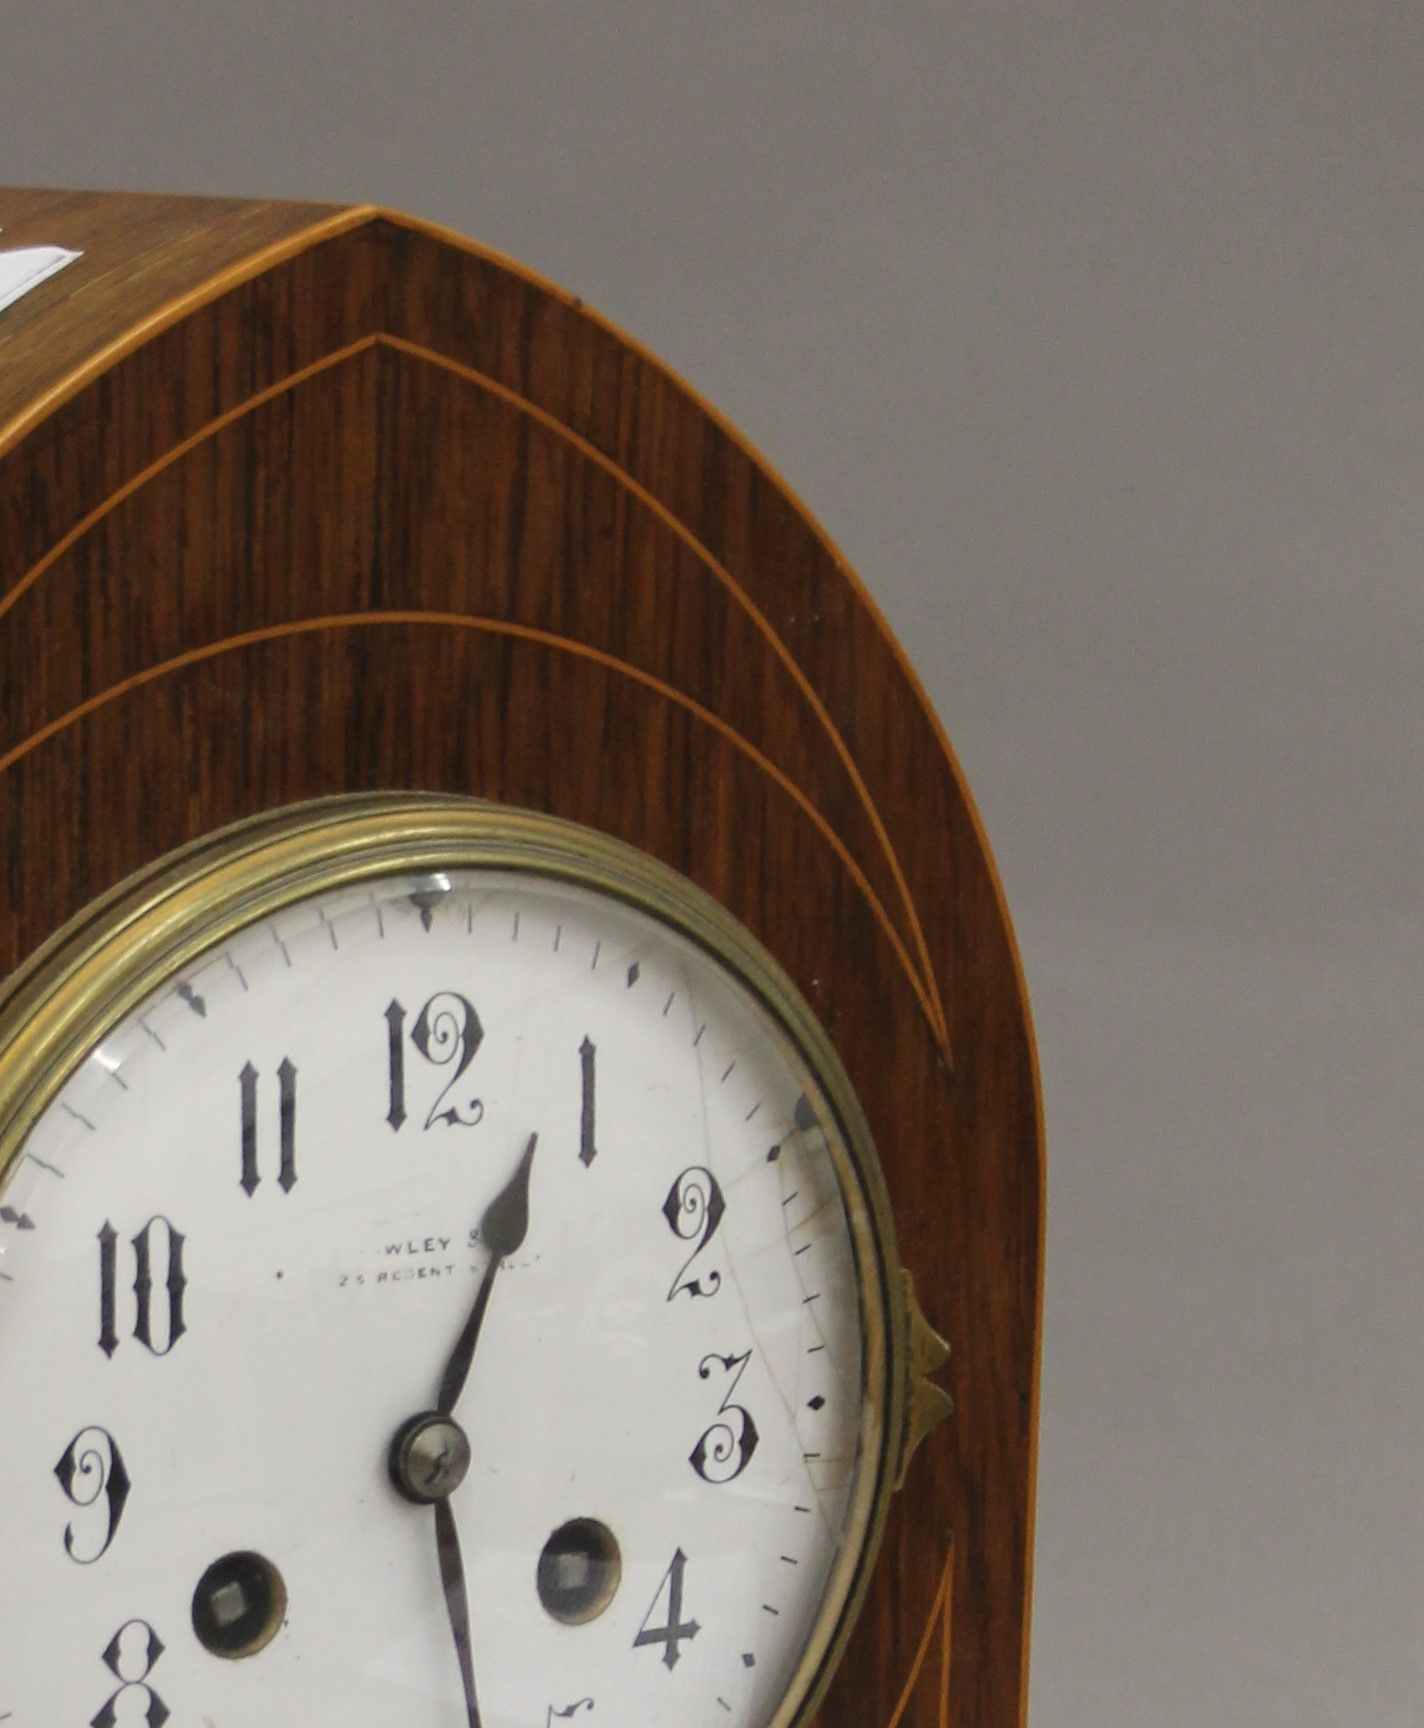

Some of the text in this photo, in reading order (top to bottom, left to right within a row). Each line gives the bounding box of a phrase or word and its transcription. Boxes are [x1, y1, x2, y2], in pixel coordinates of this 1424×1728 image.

[239, 1057, 297, 1198] 11
[385, 990, 486, 1133] 12
[578, 1035, 598, 1168] 1
[95, 1214, 187, 1359] 10
[662, 1165, 726, 1303] 2
[688, 1349, 760, 1483] 3
[52, 1424, 132, 1565] 9
[633, 1546, 701, 1671] 4
